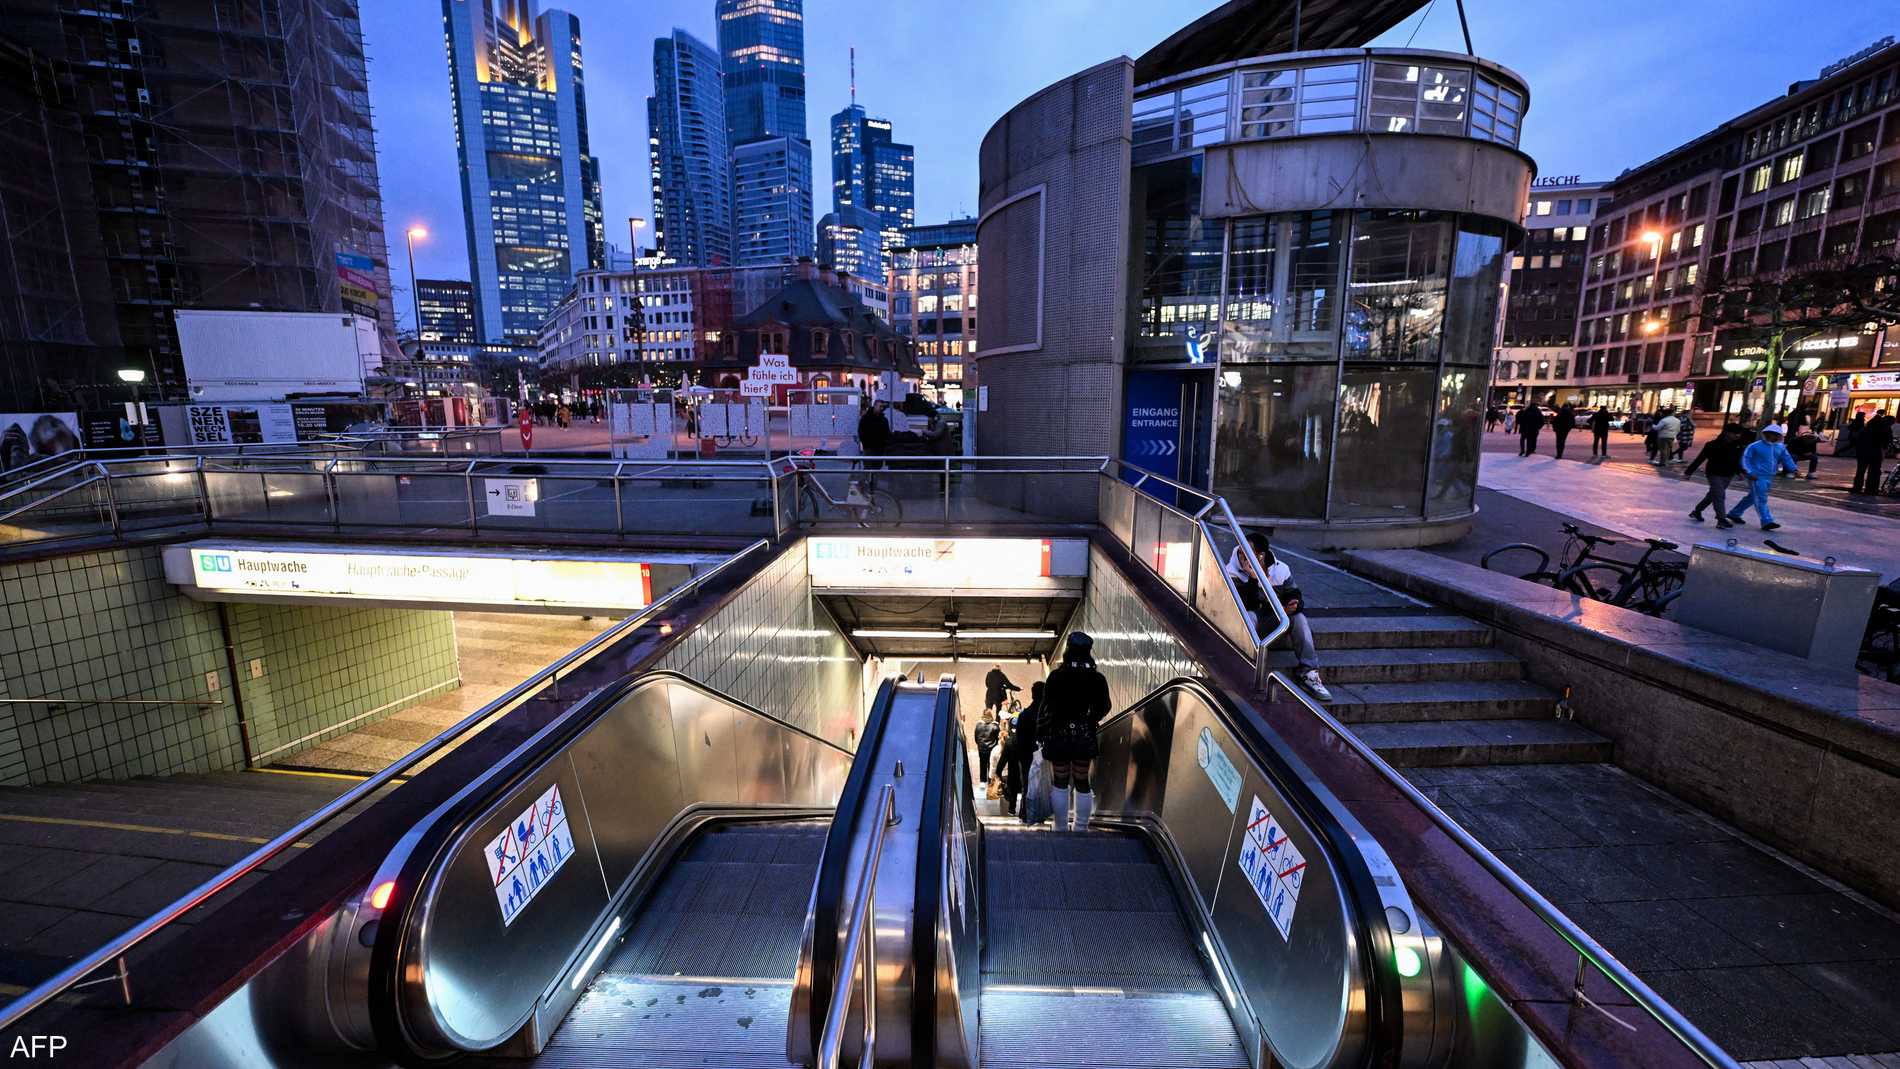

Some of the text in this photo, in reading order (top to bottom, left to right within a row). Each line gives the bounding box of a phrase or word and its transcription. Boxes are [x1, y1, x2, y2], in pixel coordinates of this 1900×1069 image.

[763, 358, 785, 368] Was
[752, 369, 794, 381] fühle ich
[744, 383, 769, 394] hier?
[190, 406, 223, 417] SZE
[1132, 408, 1178, 417] EINGANG
[192, 416, 225, 426] NEN
[1131, 419, 1178, 428] ENTRANCE
[193, 425, 226, 433] WECH
[195, 432, 228, 442] SEL
[857, 545, 932, 559] Hauptwache
[238, 558, 308, 574] Hauptwache
[641, 568, 650, 577] 10
